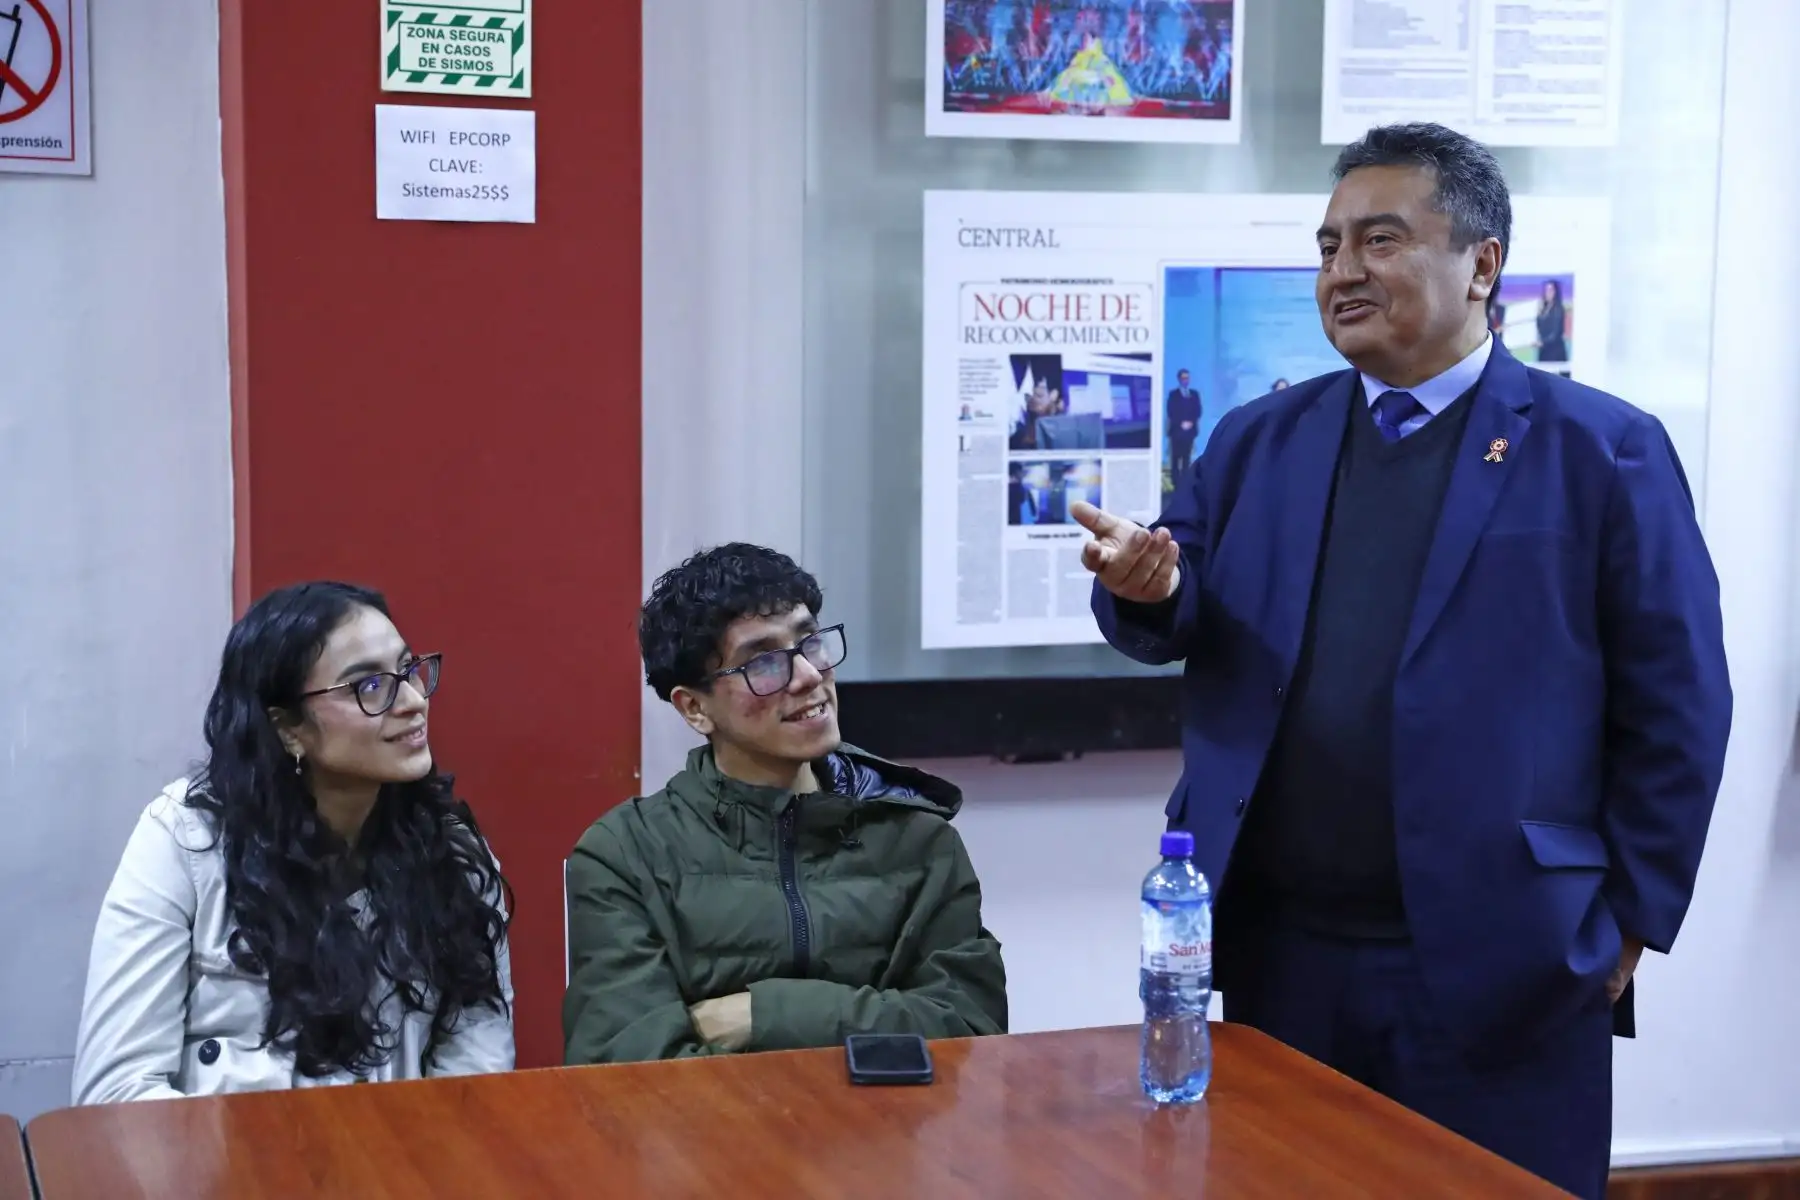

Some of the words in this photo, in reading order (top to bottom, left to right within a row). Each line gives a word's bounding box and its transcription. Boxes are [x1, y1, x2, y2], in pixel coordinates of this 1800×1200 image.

[406, 27, 445, 40] ZONA
[450, 29, 505, 43] SEGURA
[421, 42, 440, 54] EN
[444, 44, 491, 57] CASOS
[418, 57, 437, 68] DE
[440, 58, 494, 72] SISMOS
[0, 136, 63, 149] prensión
[400, 129, 436, 144] WIFI
[449, 131, 511, 147] EPCORP
[429, 158, 483, 174] CLAVE:
[402, 183, 510, 201] Sistemas25$$
[958, 227, 1061, 249] CENTRAL
[973, 292, 1092, 322] NOCHE
[1100, 292, 1142, 322] DE
[964, 325, 1150, 345] RECONOCIMIENTO
[1169, 943, 1198, 957] San
